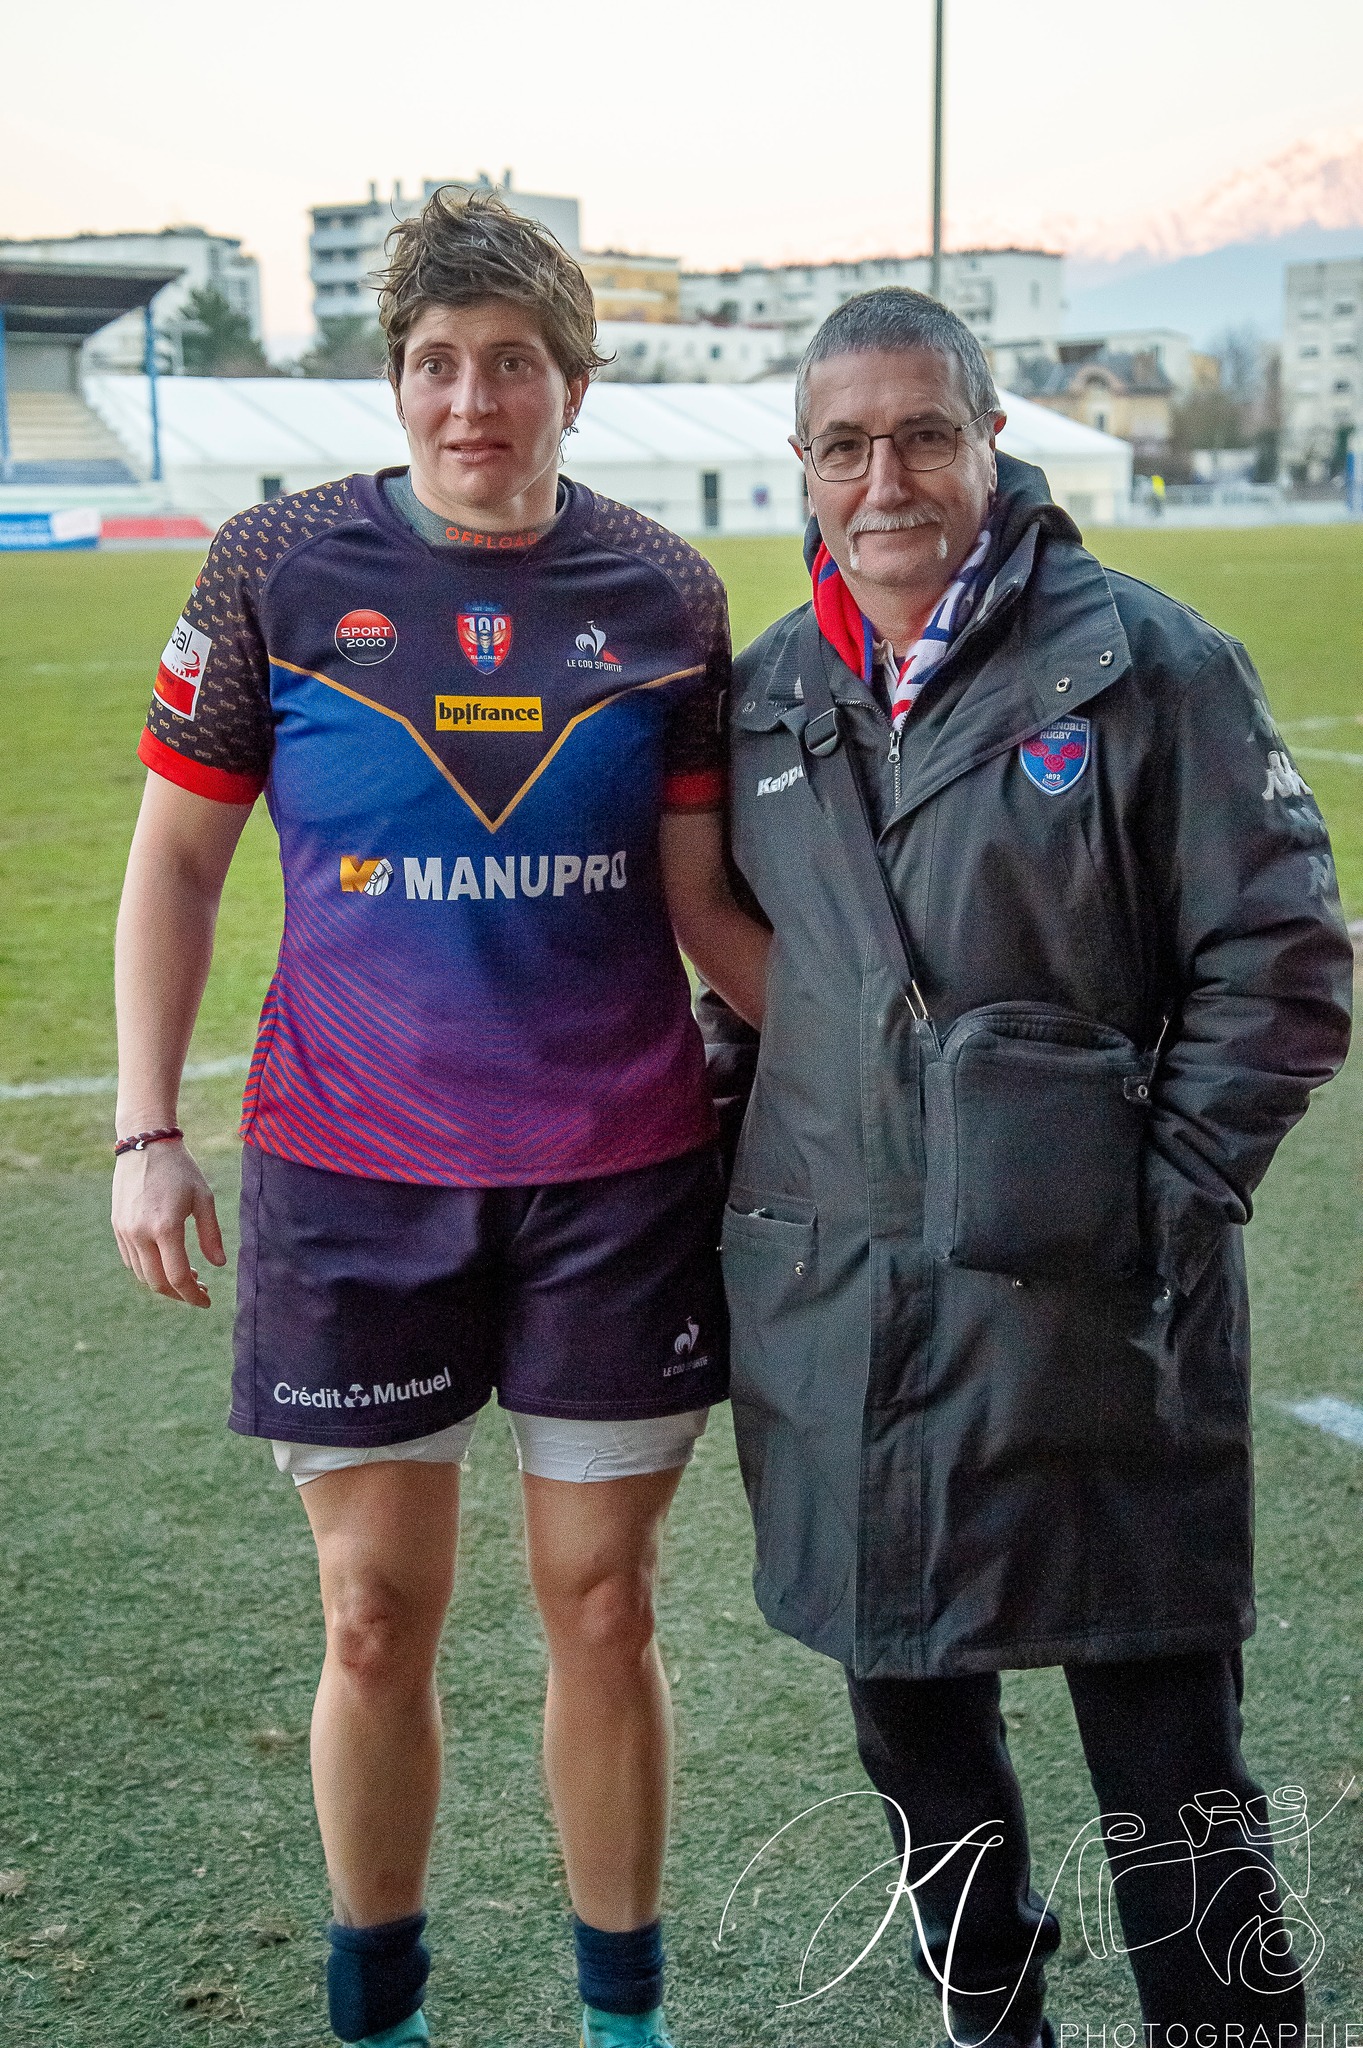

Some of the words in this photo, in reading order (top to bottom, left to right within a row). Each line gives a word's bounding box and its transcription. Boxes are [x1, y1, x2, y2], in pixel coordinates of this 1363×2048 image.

[445, 526, 537, 549] OFFLOAD
[341, 627, 390, 637] SPORT
[346, 638, 386, 648] 2000
[566, 659, 576, 668] LE
[577, 660, 593, 669] COQ
[594, 660, 623, 672] SPORTIF
[439, 702, 540, 725] bpifrance
[1050, 722, 1087, 732] ENOBLE
[1040, 731, 1071, 740] RUGBY
[403, 851, 627, 901] MANUPRO
[663, 1366, 672, 1377] LE
[274, 1382, 342, 1408] Crédit
[373, 1366, 452, 1405] Mutuel
